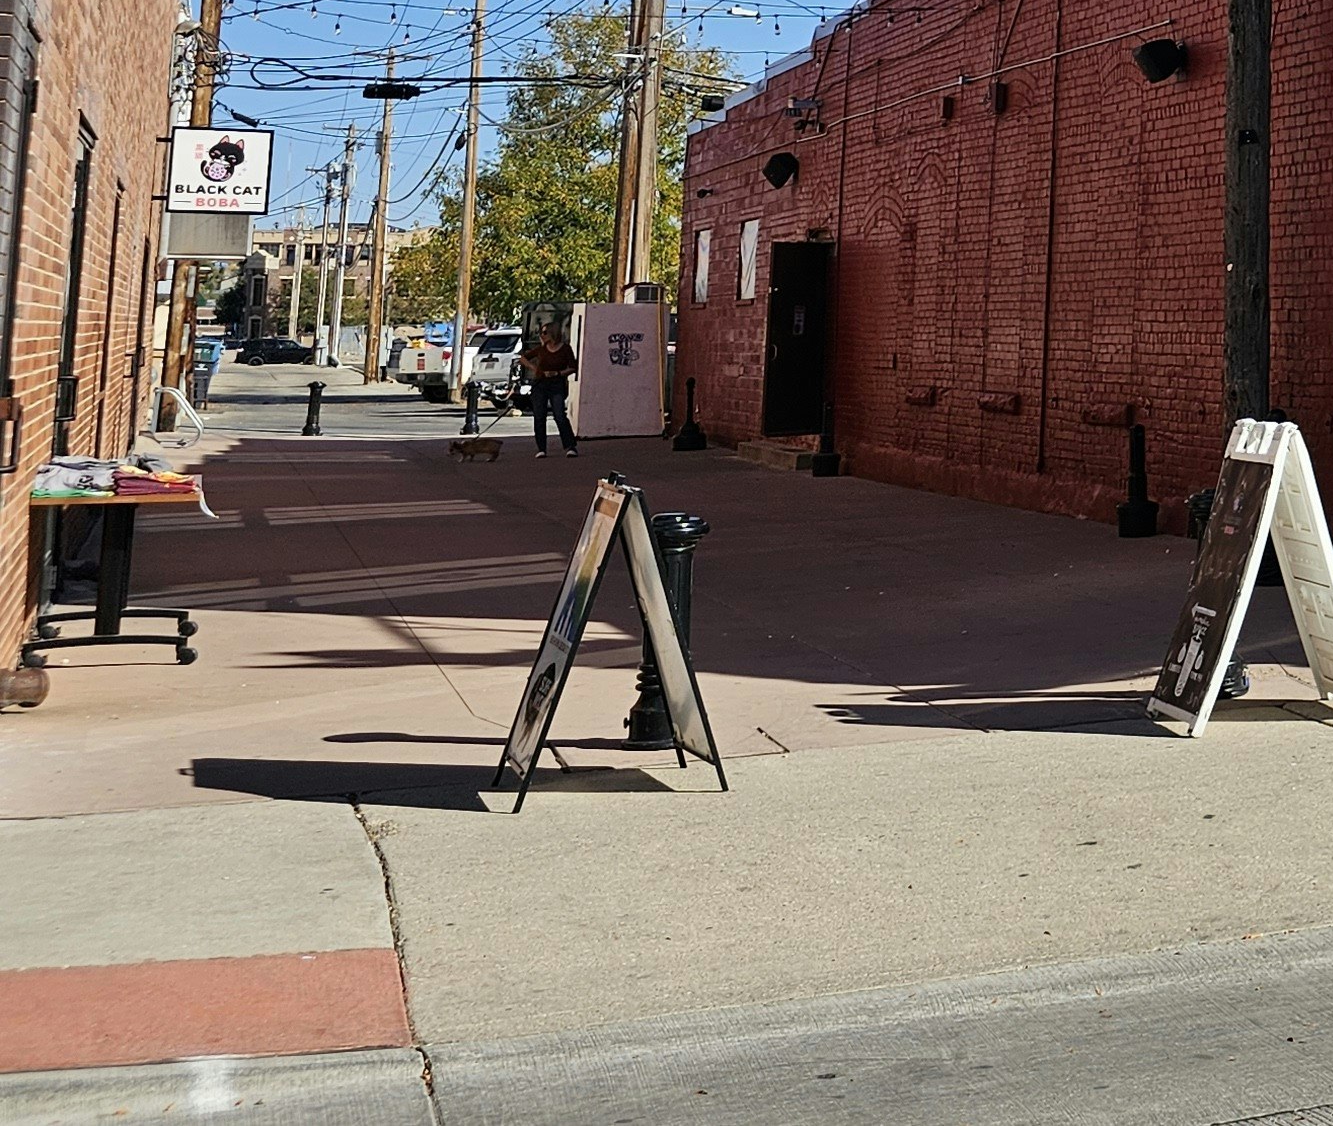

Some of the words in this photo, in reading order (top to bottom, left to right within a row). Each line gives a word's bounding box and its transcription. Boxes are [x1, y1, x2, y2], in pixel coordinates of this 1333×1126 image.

[175, 184, 228, 195] BLACK
[232, 186, 263, 196] CAT
[195, 197, 240, 208] BOBA
